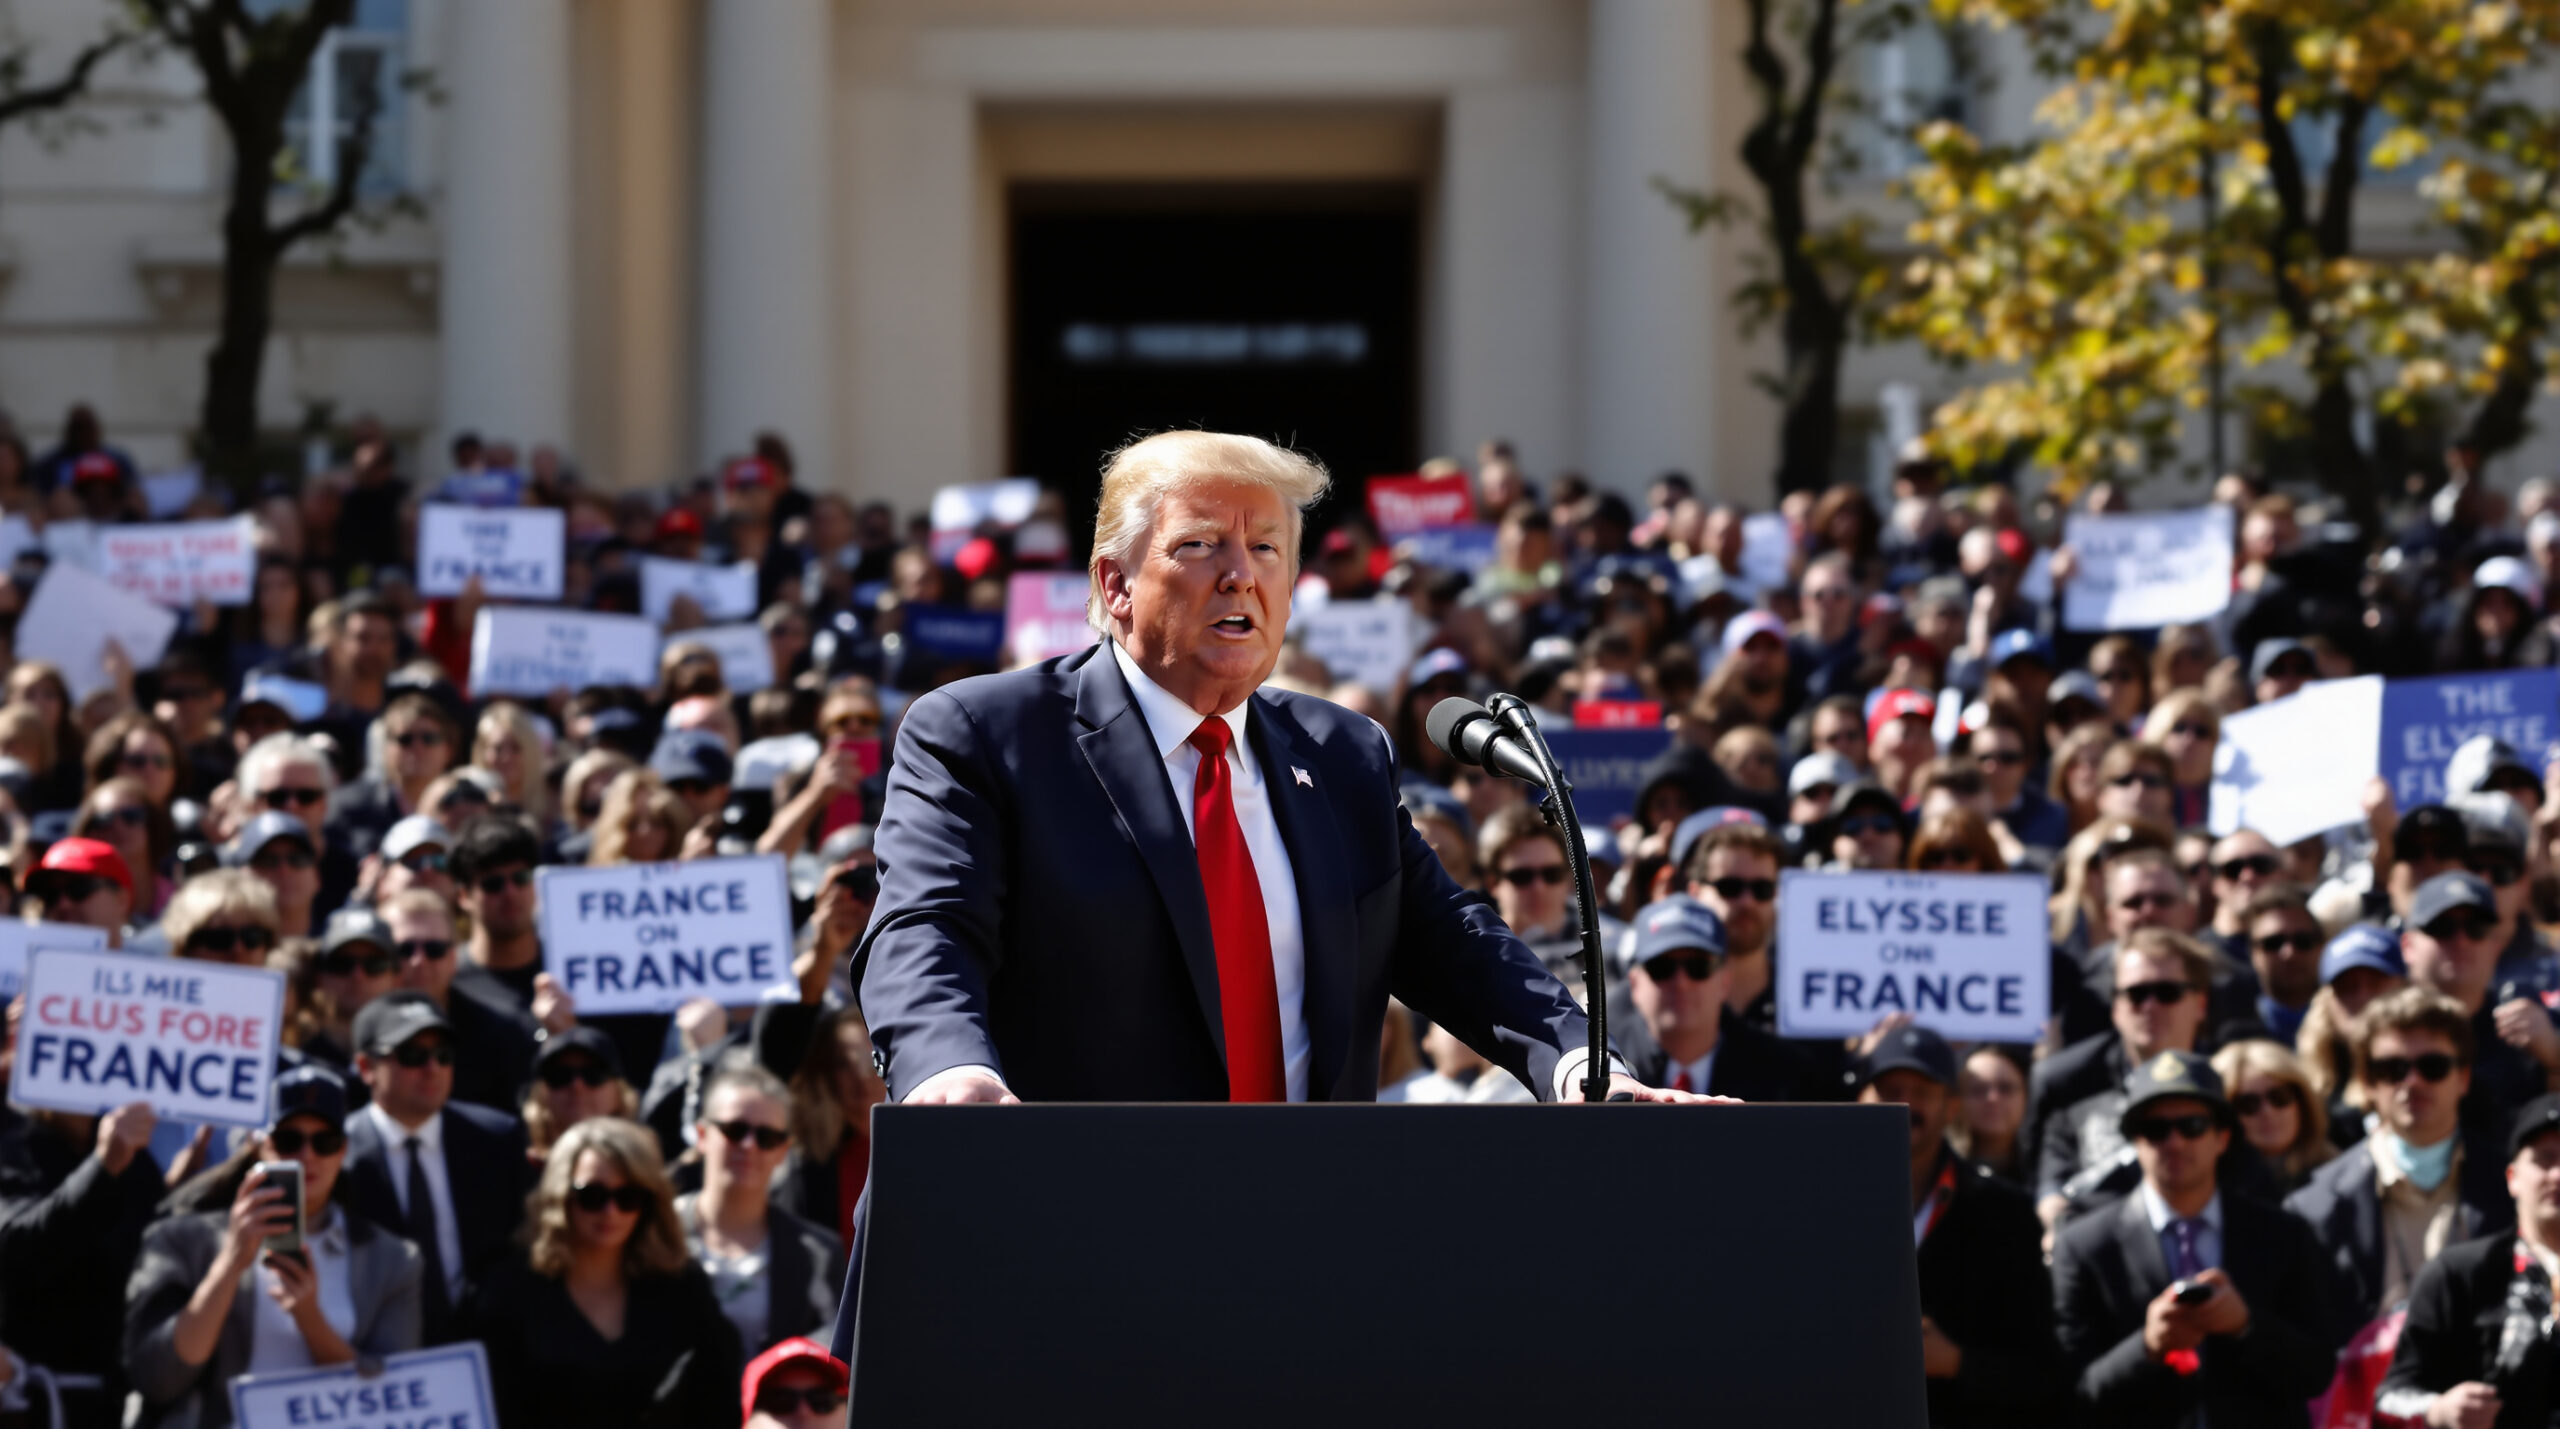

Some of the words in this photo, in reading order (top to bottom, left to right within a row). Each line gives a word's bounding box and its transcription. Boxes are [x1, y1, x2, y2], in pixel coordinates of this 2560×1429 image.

[2439, 680, 2516, 716] THE
[578, 881, 748, 921] FRANCE
[1817, 898, 2007, 935] ELYSSEE
[637, 924, 678, 946] ON
[565, 943, 775, 992] FRANCE
[142, 974, 203, 1004] MIE
[1803, 971, 2023, 1015] FRANCE
[38, 996, 144, 1035] CLUS
[158, 1007, 263, 1050] FORE
[29, 1035, 260, 1102] FRANCE
[286, 1378, 429, 1425] ELYSEE
